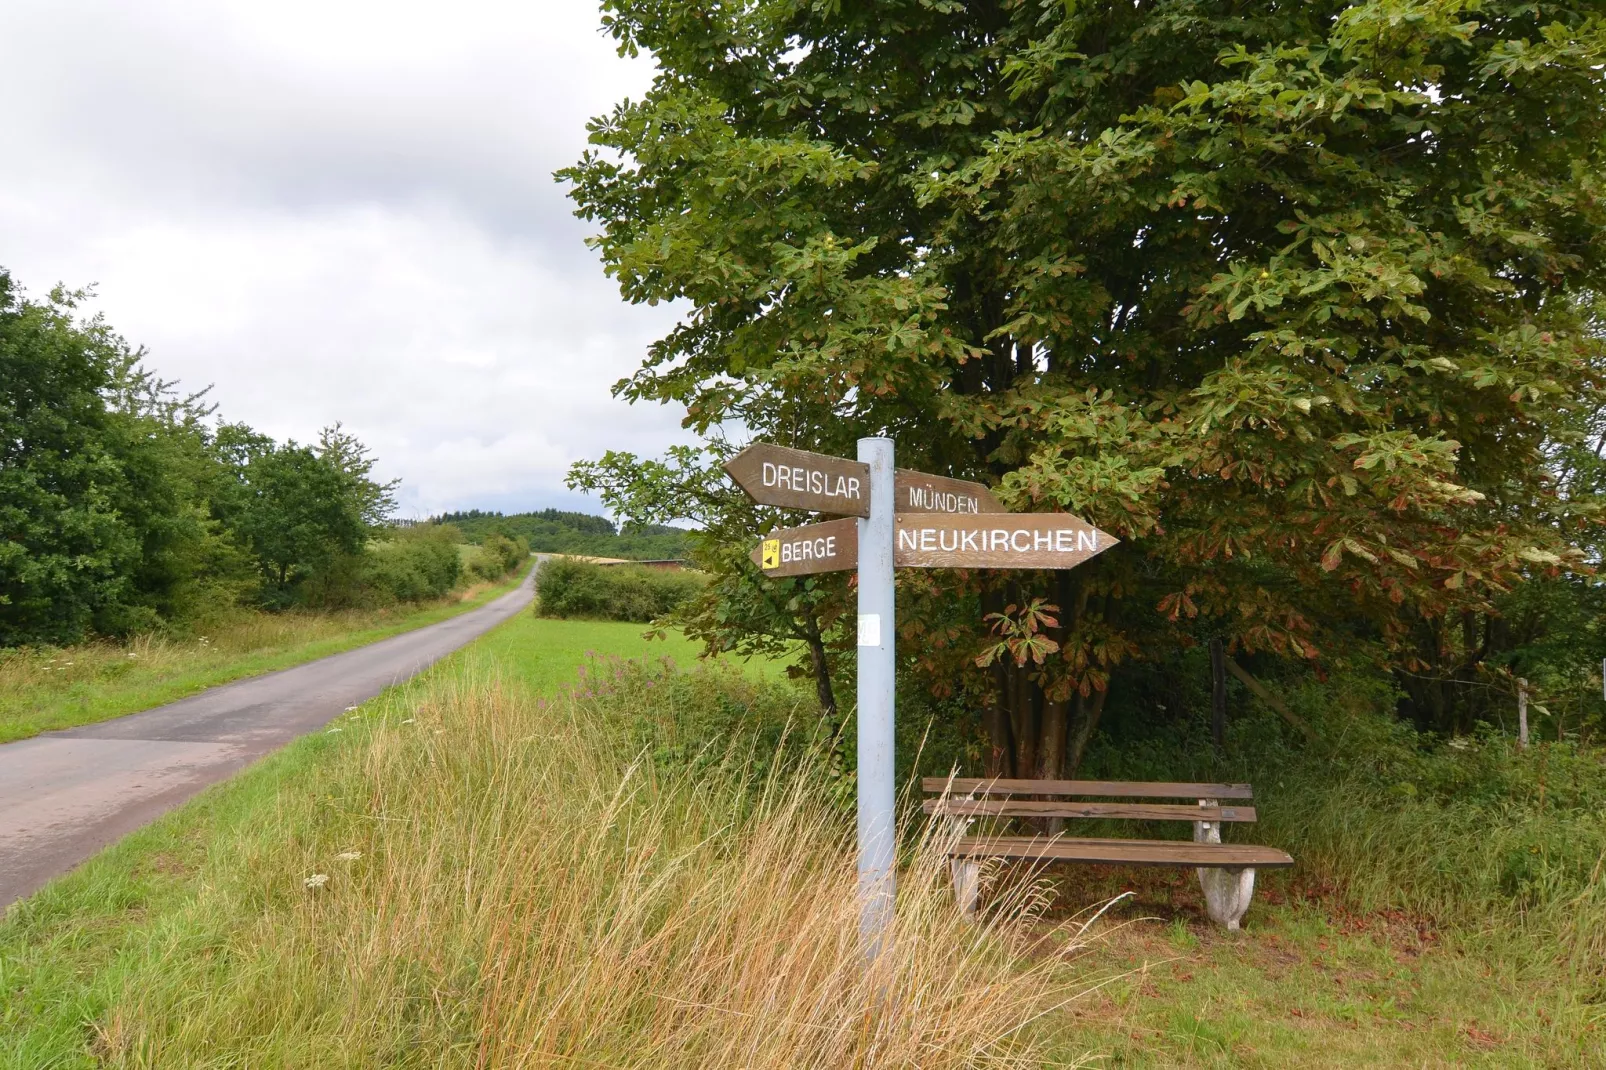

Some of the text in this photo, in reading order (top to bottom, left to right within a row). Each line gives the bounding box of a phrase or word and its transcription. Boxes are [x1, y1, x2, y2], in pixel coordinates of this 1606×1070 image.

[762, 462, 860, 499] DREISLAR
[909, 484, 978, 514] MÜNDEN
[782, 536, 836, 562] BERGE
[898, 528, 1097, 552] NEUKIRCHEN
